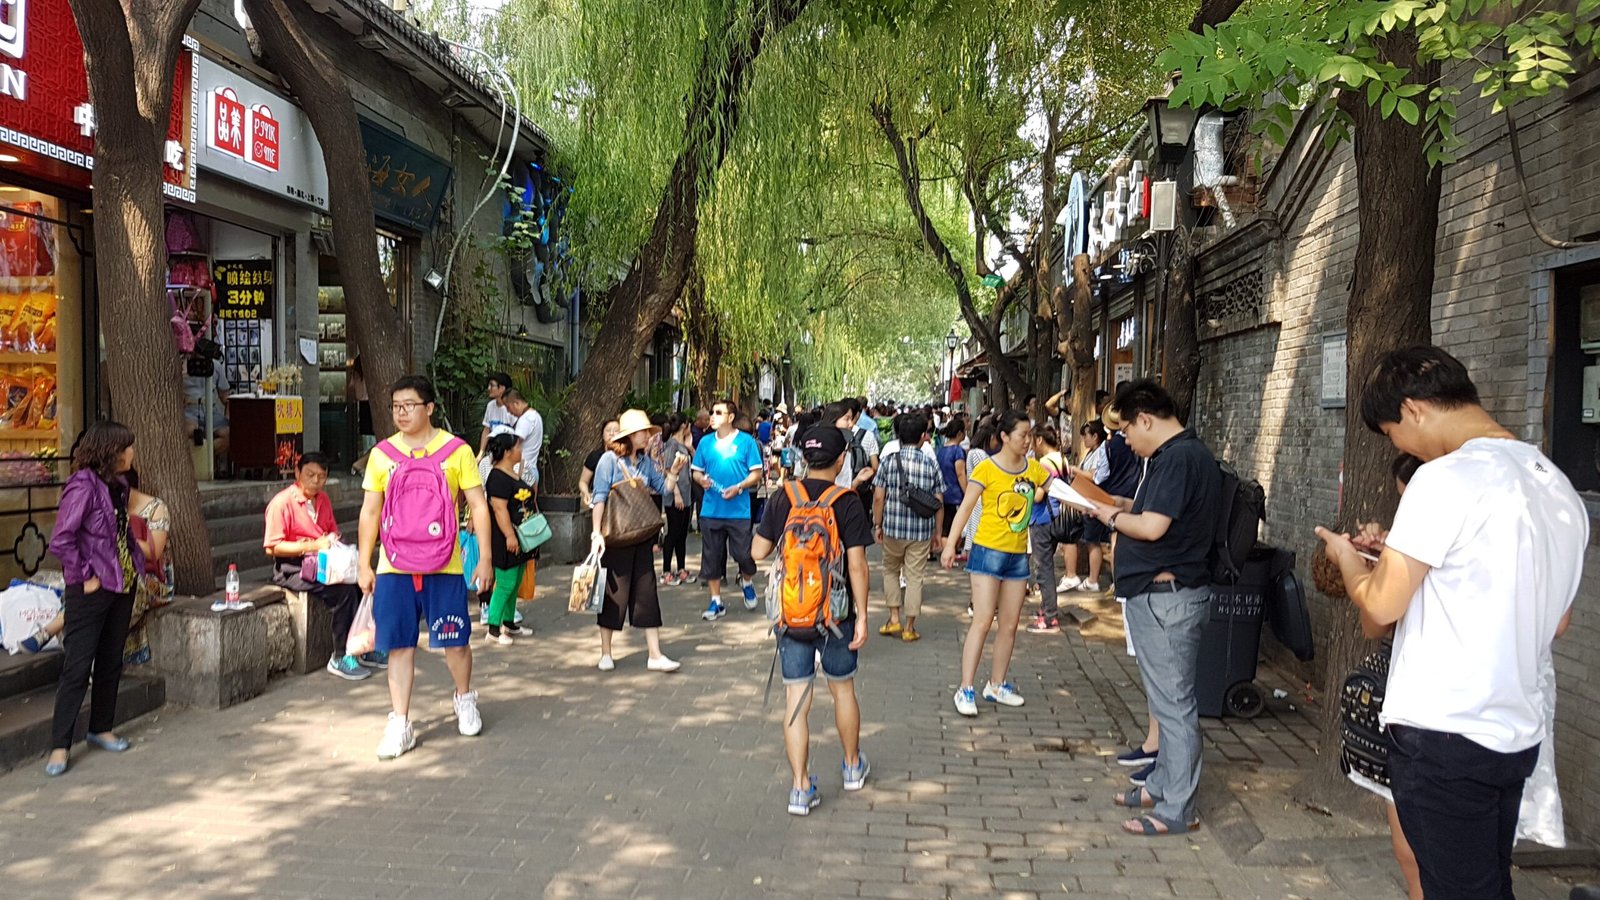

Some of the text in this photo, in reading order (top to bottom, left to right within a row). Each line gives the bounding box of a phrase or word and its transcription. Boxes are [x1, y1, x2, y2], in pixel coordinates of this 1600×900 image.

[227, 270, 273, 286] 喷绘纹身
[228, 289, 265, 306] 3分钟
